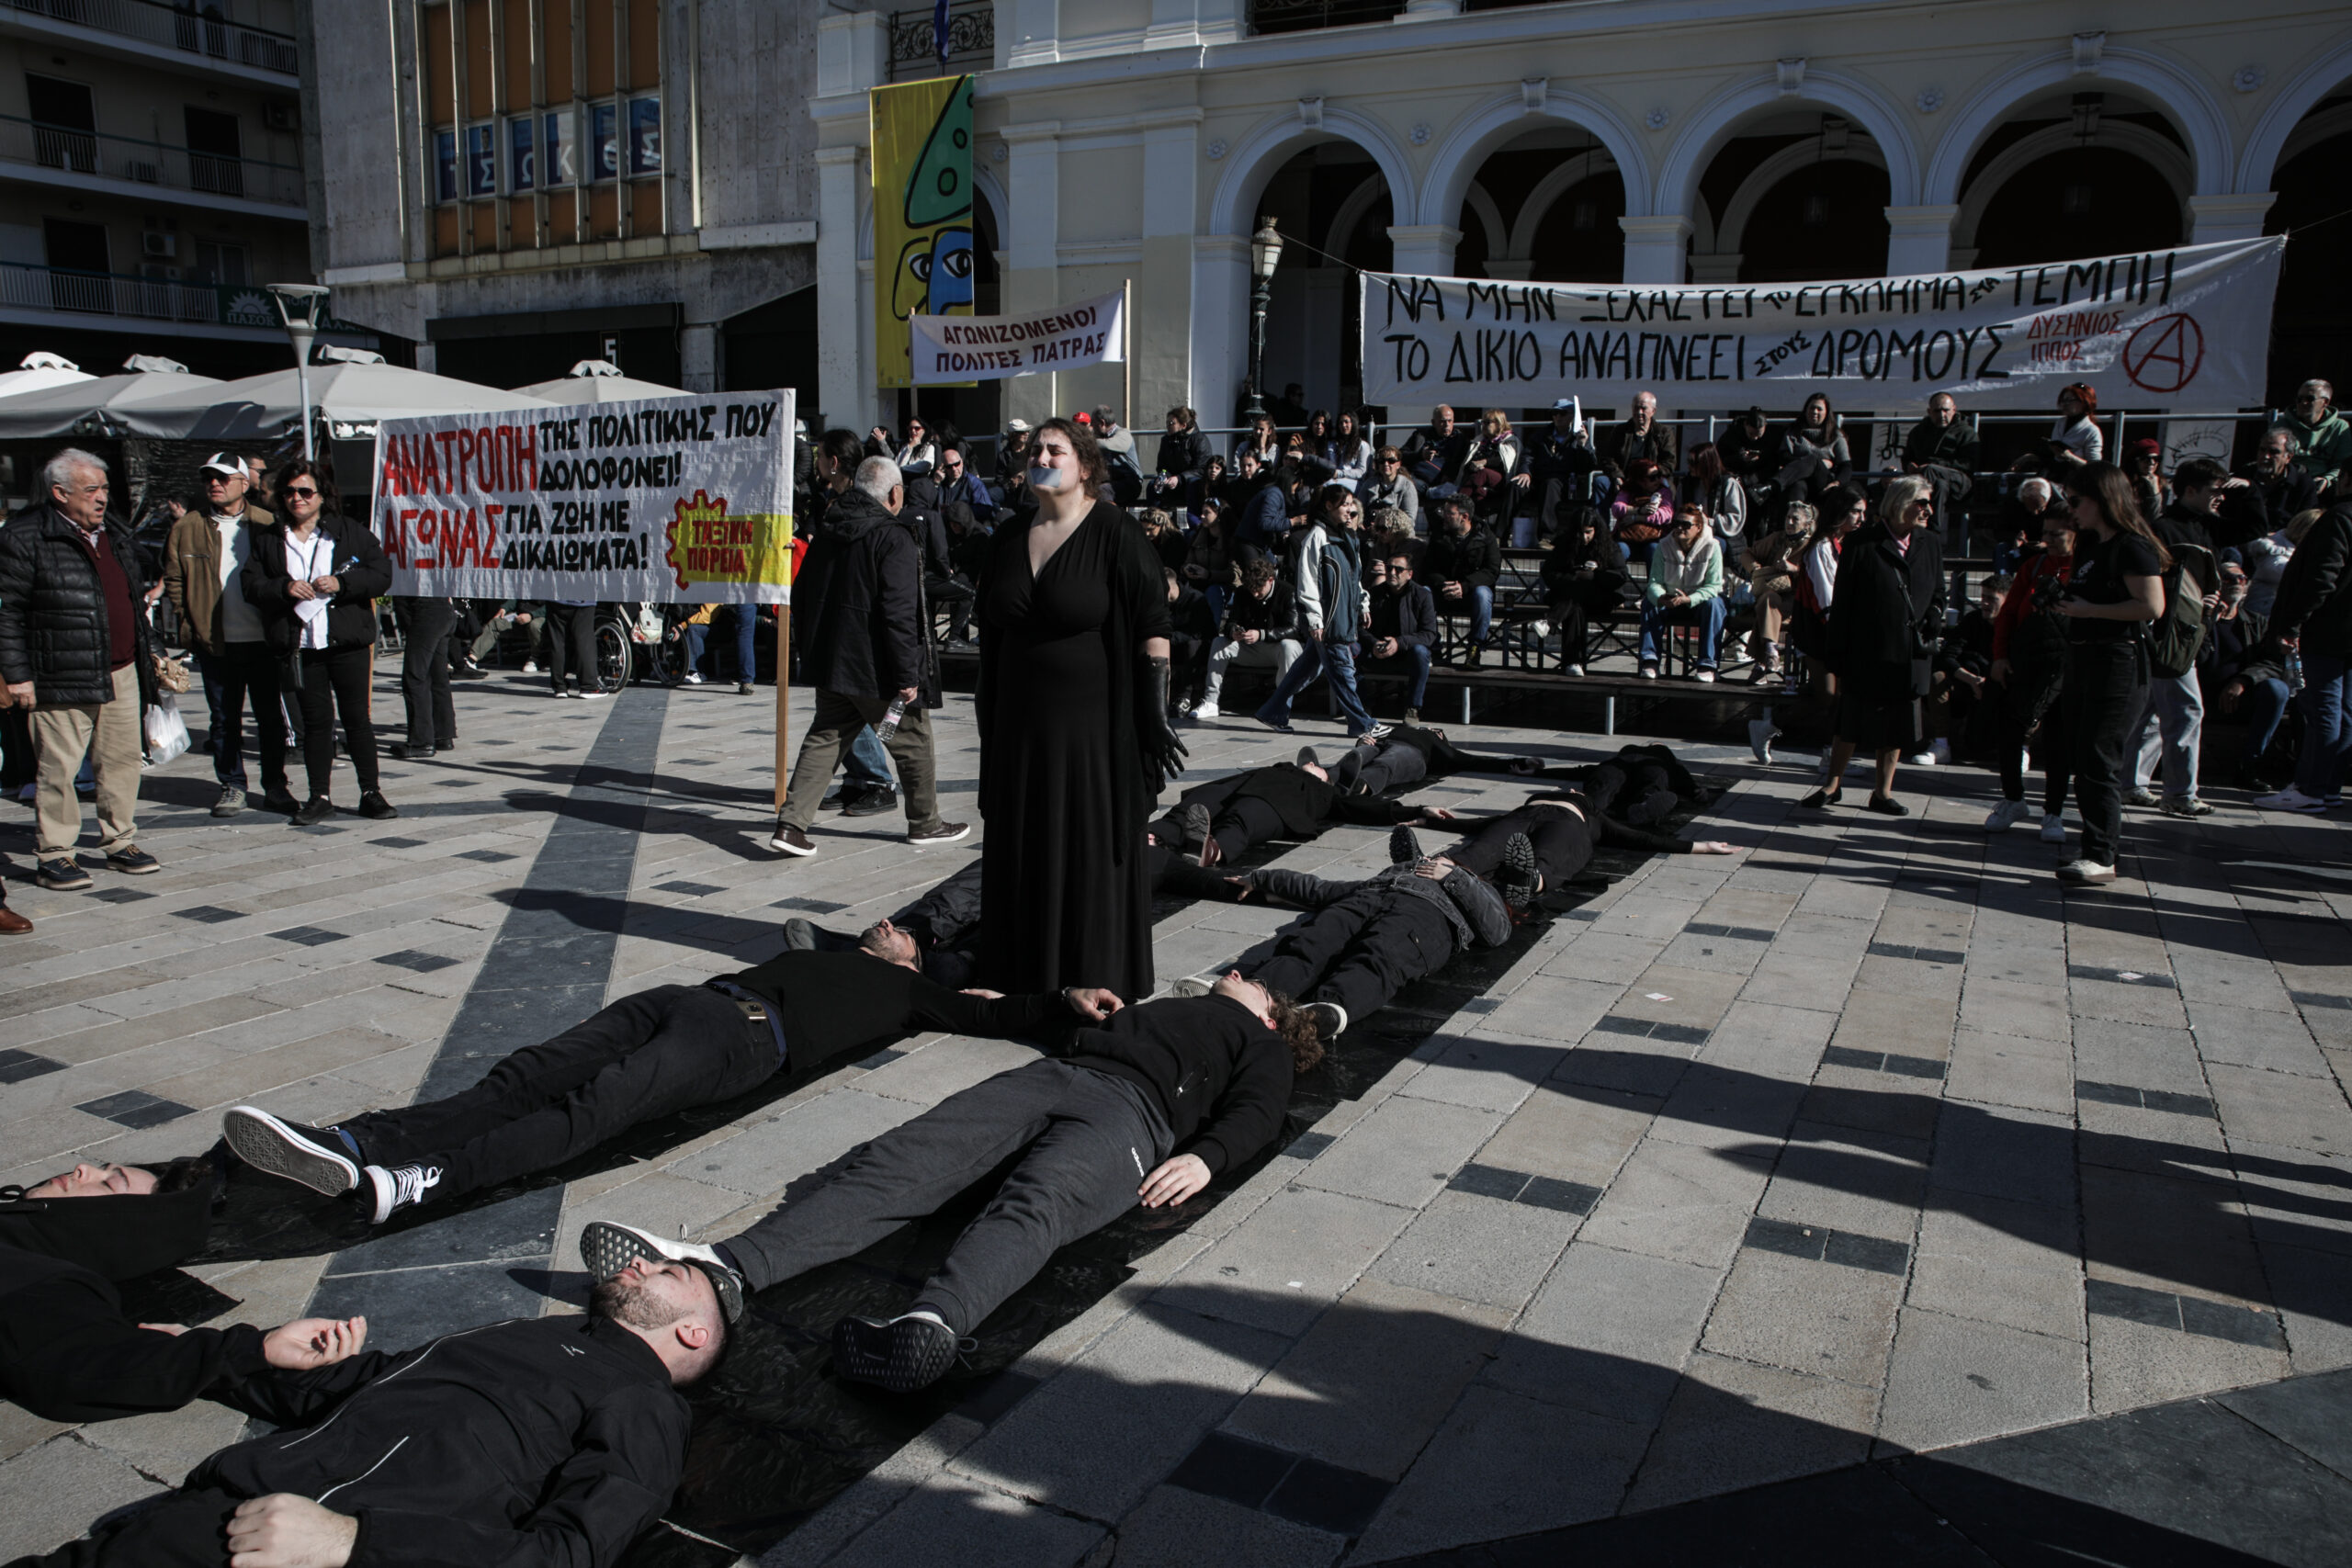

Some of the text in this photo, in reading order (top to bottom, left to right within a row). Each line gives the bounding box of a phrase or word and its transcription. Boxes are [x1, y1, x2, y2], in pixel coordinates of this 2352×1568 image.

[1379, 276, 1445, 333] ΝΑ
[1465, 281, 1557, 323] ΜΗΝ
[1763, 289, 1792, 310] ΤΟ
[1795, 276, 1966, 317] ΕΓΚΛΗΜΑ
[1968, 276, 2002, 305] ΣΤΑ
[2005, 252, 2177, 306] ΤΕΜΠΗ
[227, 312, 277, 327] ΠΑΣΟΚ
[944, 306, 1097, 344] ΑΓΩΝΙΖΟΜΕΝΟΙ
[2026, 310, 2125, 340] ΔΥΣΗΝΙΟΣ
[936, 332, 1106, 373] ΠΟΛΙΤΕΣ ΠΑΤΡΑΣ
[1383, 323, 2016, 383] ΤΟ ΔΙΚΙΟ ΑΝΑΠΝΕΕΙ ΣΤΟΥΣ ΔΡΟΜΟΥΣ
[2030, 339, 2084, 362] ΙΠΠΟΣ
[380, 401, 777, 497] ΑΝΑΤΡΟΠΗ ΤΗΣ ΠΟΛΙΤΙΚΗΣ ΠΟΥ
[538, 451, 682, 492] ΔΟΛΟΦΟΝΕΙ!
[382, 500, 630, 570] ΑΓΩΝΑΣ ΓΙΑ ΖΩΗ ΜΕ
[503, 532, 649, 572] ΔΙΚΑΙΩΜΑΤΑ!
[691, 520, 753, 545] ΤΑΞΙΚΗ
[686, 547, 746, 573] ΠΟΡΕΙΑ
